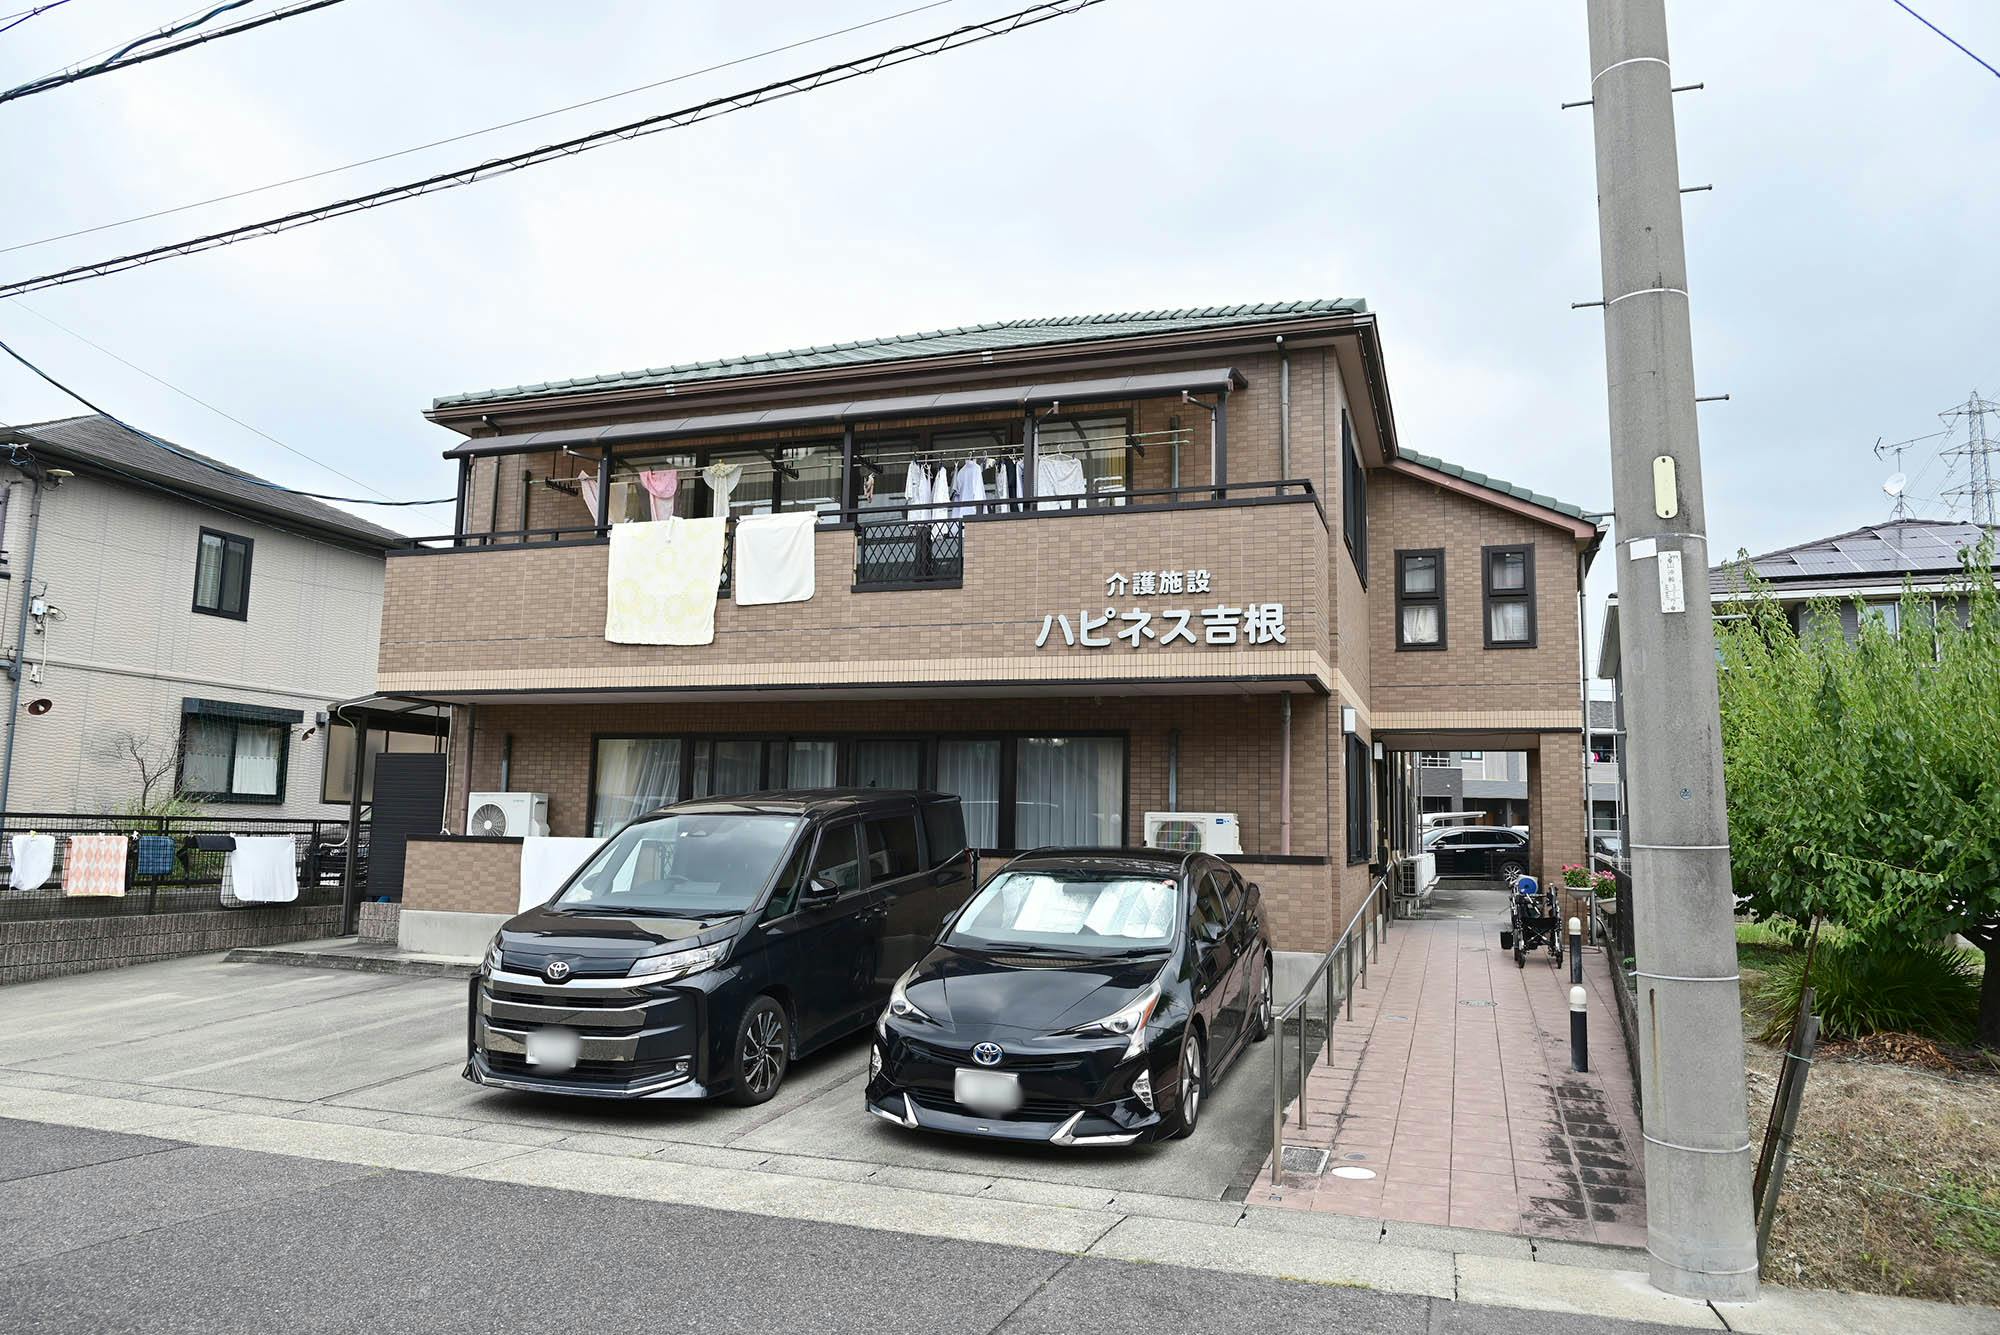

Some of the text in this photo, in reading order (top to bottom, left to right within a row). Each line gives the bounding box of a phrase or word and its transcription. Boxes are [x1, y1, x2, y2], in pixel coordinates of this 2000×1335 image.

[1106, 569, 1212, 597] 介護施設
[1035, 603, 1287, 648] ハピネス吉根
